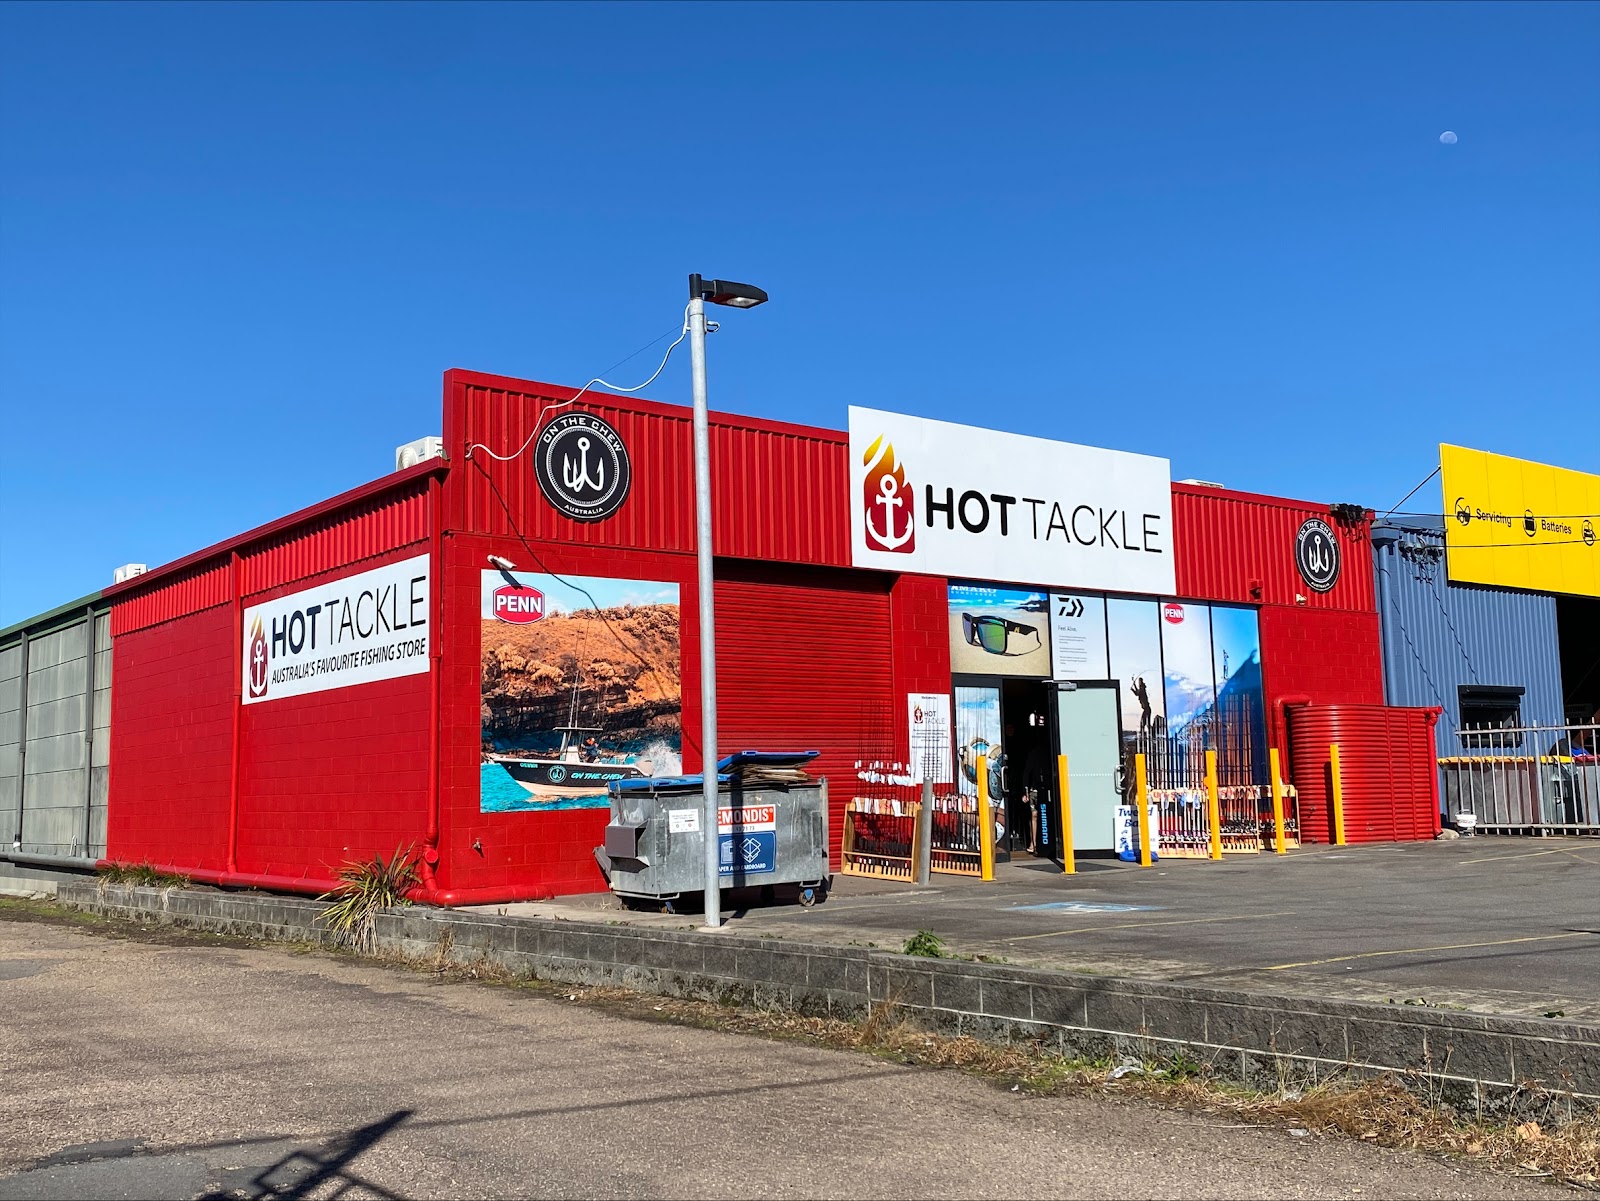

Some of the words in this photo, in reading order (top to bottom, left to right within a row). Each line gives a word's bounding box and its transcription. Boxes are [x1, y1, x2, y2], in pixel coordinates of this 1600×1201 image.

[543, 425, 559, 444] ON
[560, 417, 586, 428] THE
[591, 421, 622, 452] CHEW
[564, 504, 604, 515] AUSTRALIA
[926, 484, 1016, 536] HOT
[1022, 497, 1163, 553] TACKLE
[1476, 508, 1512, 528] Servicing
[1541, 519, 1572, 535] Batteries
[1298, 528, 1306, 541] ON
[1305, 521, 1319, 529] THE
[1319, 523, 1336, 544] CHEW
[496, 594, 542, 614] PENN
[1164, 607, 1184, 619] PENN
[272, 604, 322, 659] HOT
[324, 575, 427, 645] TACKLE
[271, 660, 316, 684] AUSTRALIA'S
[316, 652, 360, 676] FAVOURITE
[360, 646, 395, 667] FISHING
[396, 637, 427, 659] STORE
[925, 717, 946, 725] TACKLE
[570, 772, 584, 780] ON
[584, 772, 601, 780] THE
[717, 807, 769, 824] EMONDIS
[1118, 807, 1154, 817] Twed
[1040, 803, 1049, 845] SHIMANO
